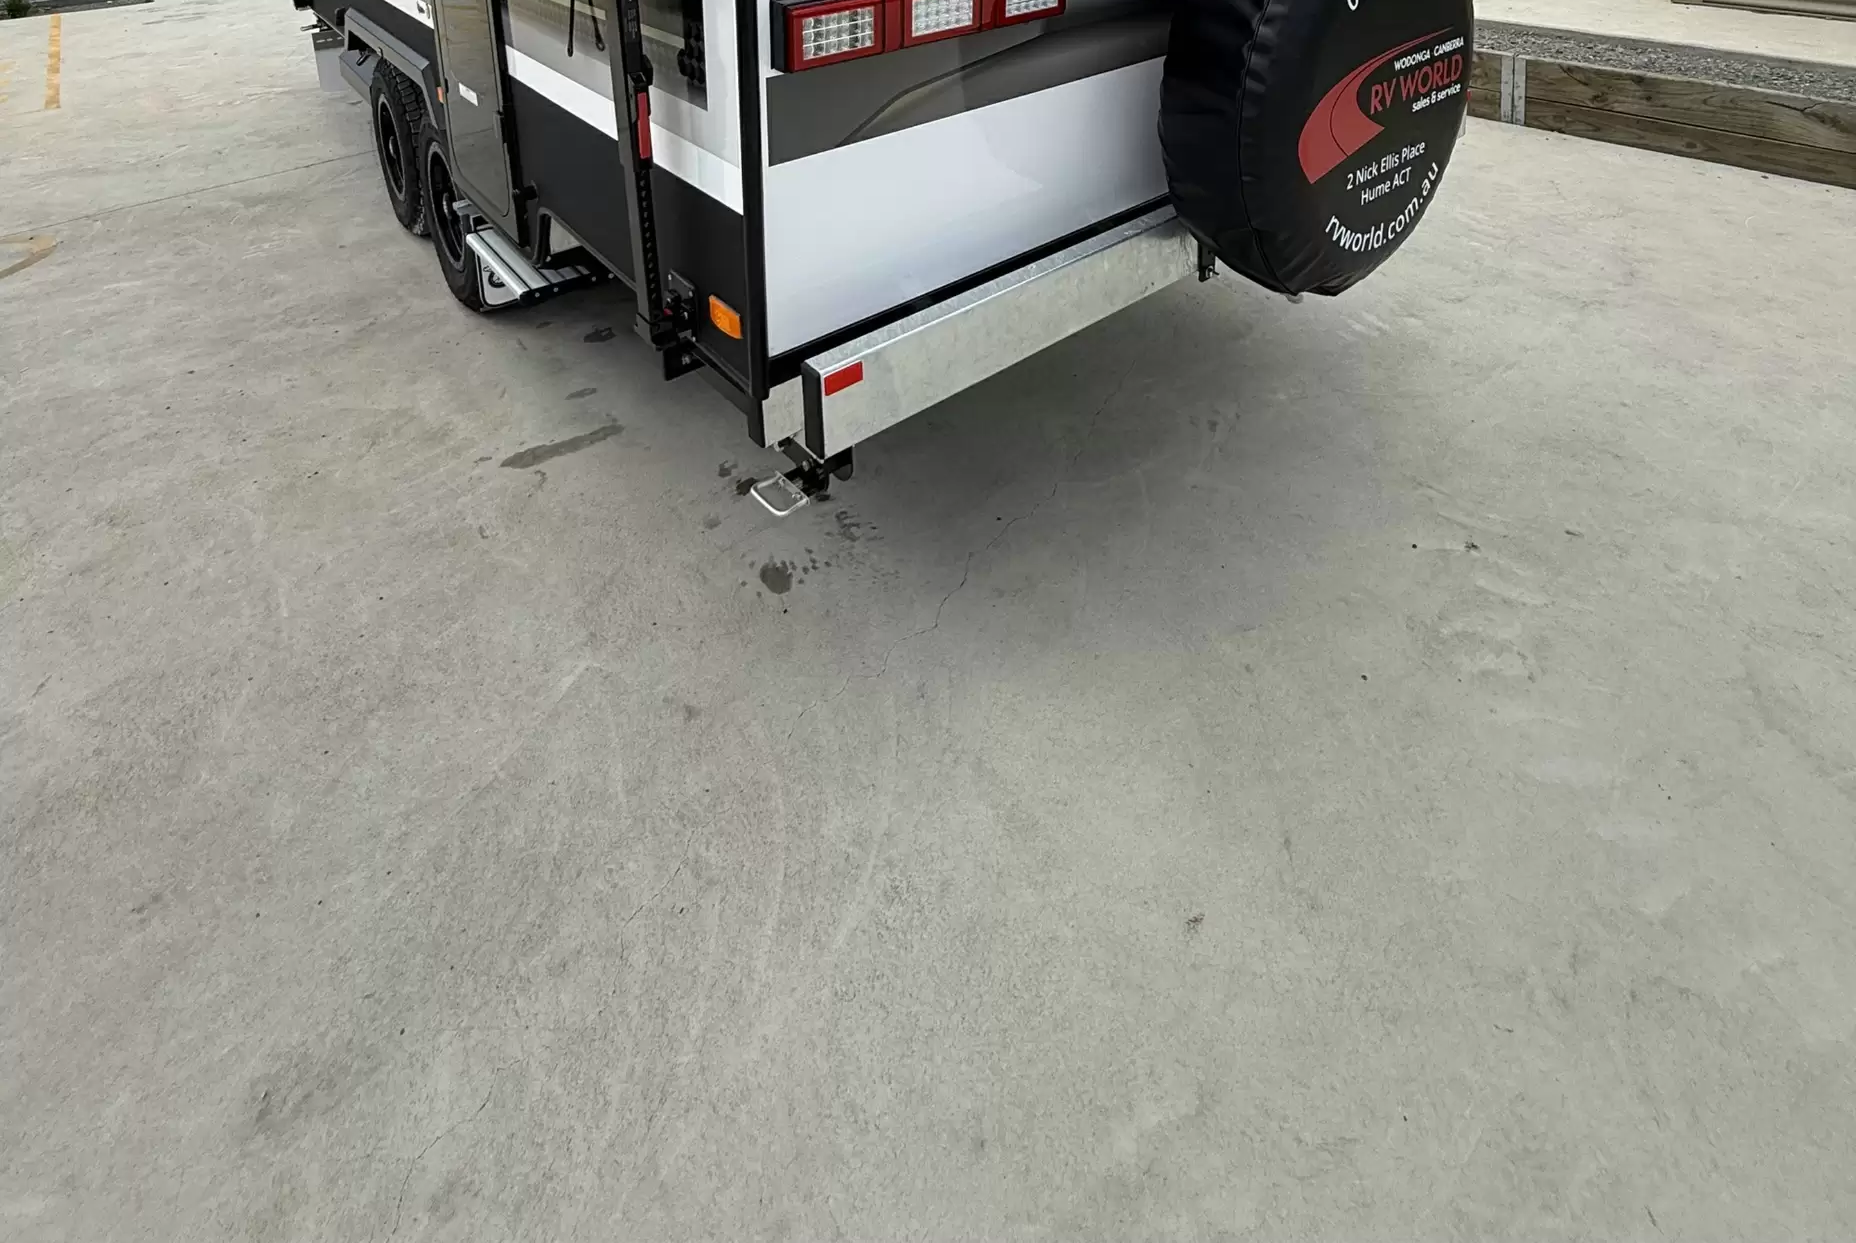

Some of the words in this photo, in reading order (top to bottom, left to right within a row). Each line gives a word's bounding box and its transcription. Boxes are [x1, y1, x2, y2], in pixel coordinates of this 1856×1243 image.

[1393, 49, 1431, 72] WODONGA
[1433, 36, 1464, 57] CANBERRA
[1370, 78, 1396, 115] RV
[1399, 54, 1463, 102] WORLD
[1411, 96, 1430, 113] sales
[1430, 91, 1437, 103] &
[1436, 83, 1461, 102] service
[1346, 173, 1354, 190] 2
[1355, 161, 1379, 186] Nick
[1380, 152, 1400, 174] Ellis
[1401, 142, 1426, 163] Place
[1360, 180, 1391, 206] Hume
[1392, 166, 1412, 190] ACT
[1325, 161, 1439, 252] rvworld.com.au
